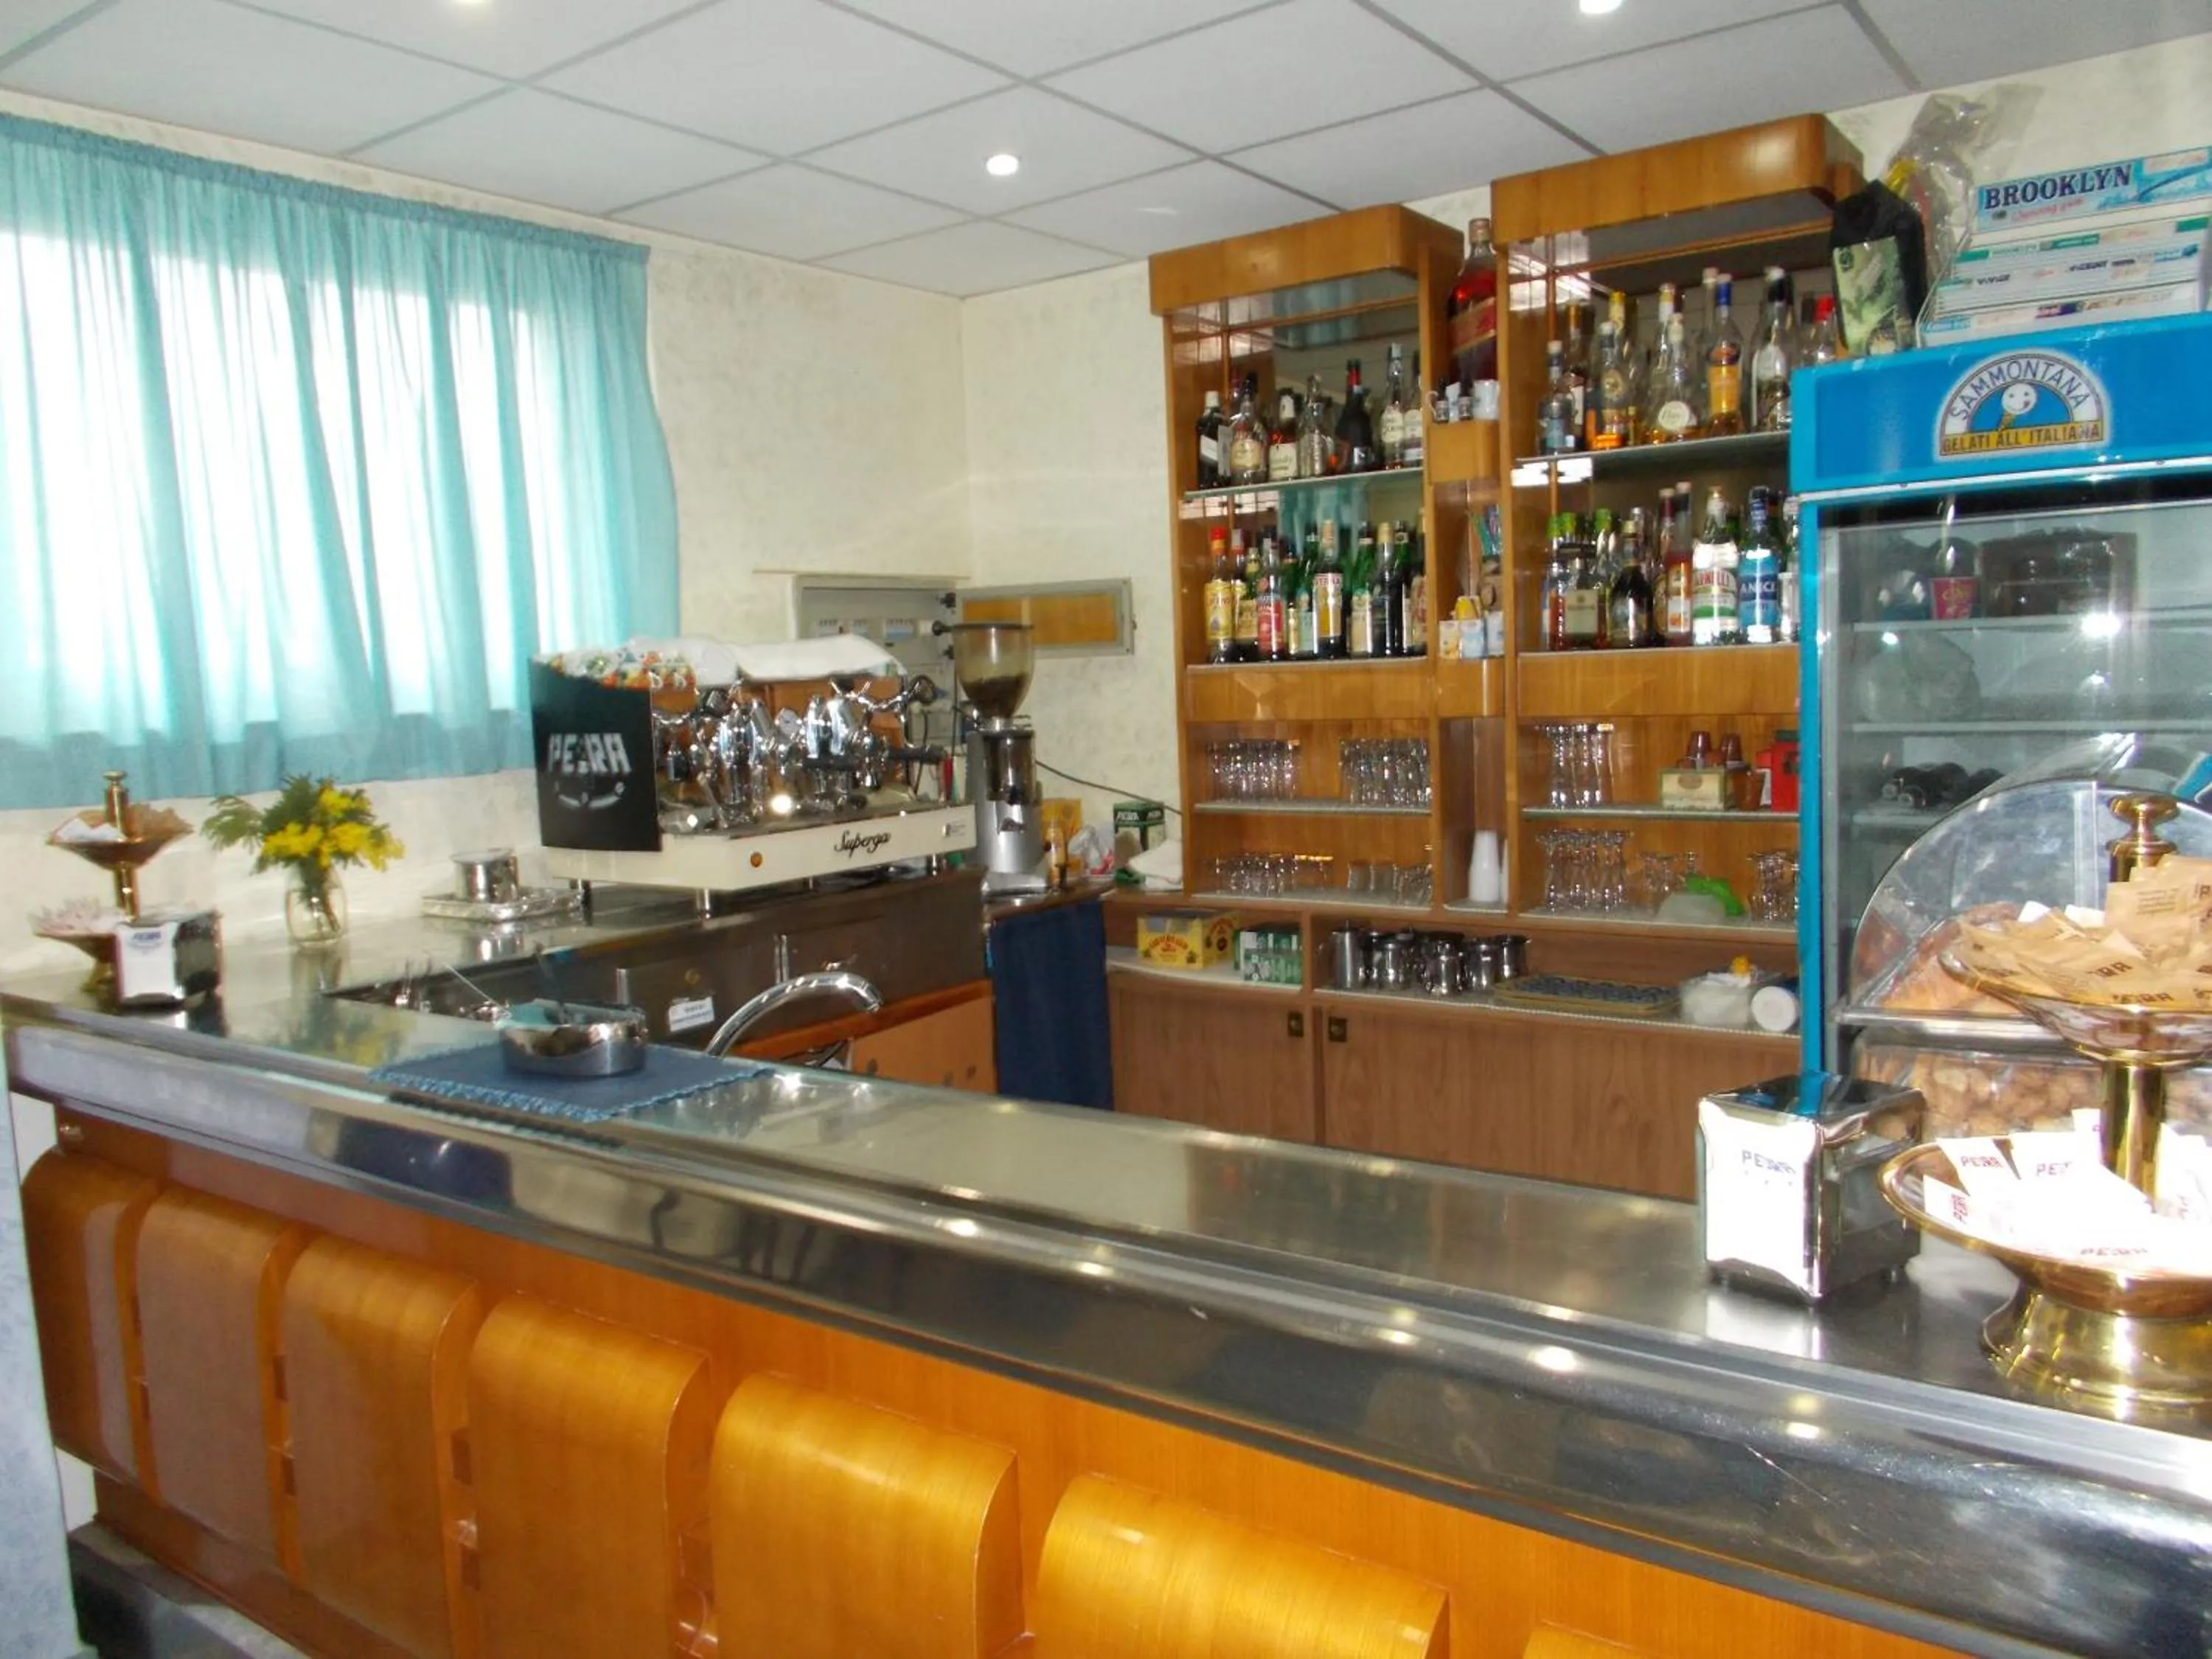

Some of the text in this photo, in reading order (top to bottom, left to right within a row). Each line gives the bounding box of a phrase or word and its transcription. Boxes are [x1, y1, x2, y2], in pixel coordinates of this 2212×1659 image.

[1984, 164, 2132, 210] BROOKLYN
[1950, 359, 2091, 421] SAMMONTANA
[834, 830, 891, 858] Superga
